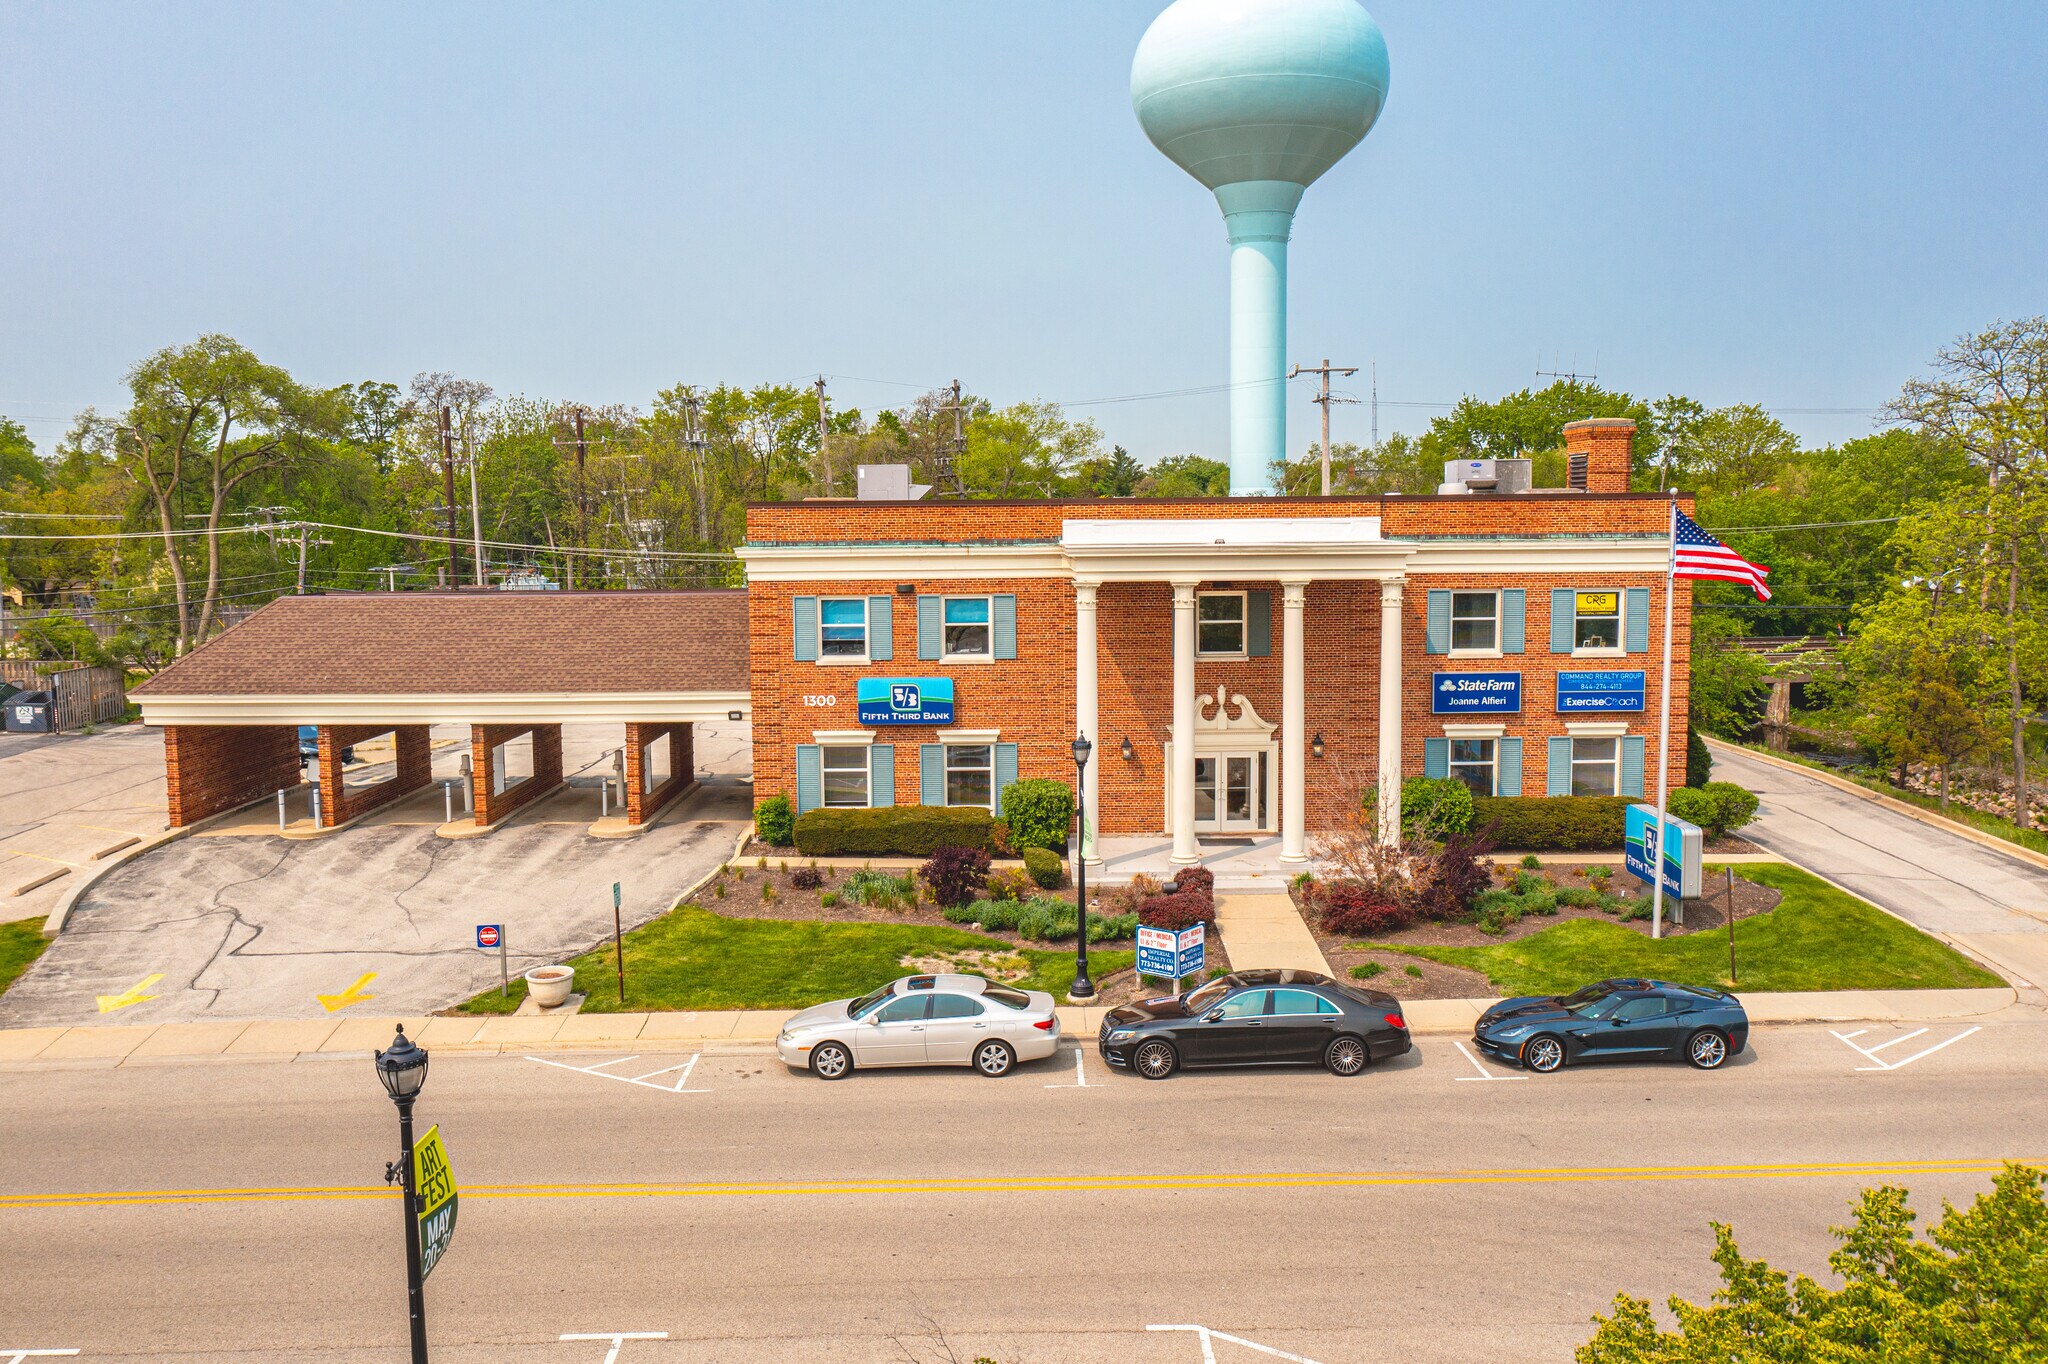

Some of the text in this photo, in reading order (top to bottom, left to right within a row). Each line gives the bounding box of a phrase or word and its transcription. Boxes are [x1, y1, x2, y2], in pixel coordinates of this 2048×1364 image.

[1586, 595, 1606, 606] CRG
[802, 695, 836, 707] 1300
[1449, 697, 1506, 705] Joanne Alfieri
[862, 712, 950, 720] FIFTH THIRD BANK
[1627, 854, 1680, 892] FIFTH THI BANK
[420, 1139, 442, 1181] ART
[421, 1165, 450, 1207] FEST
[427, 1205, 452, 1246] MAY
